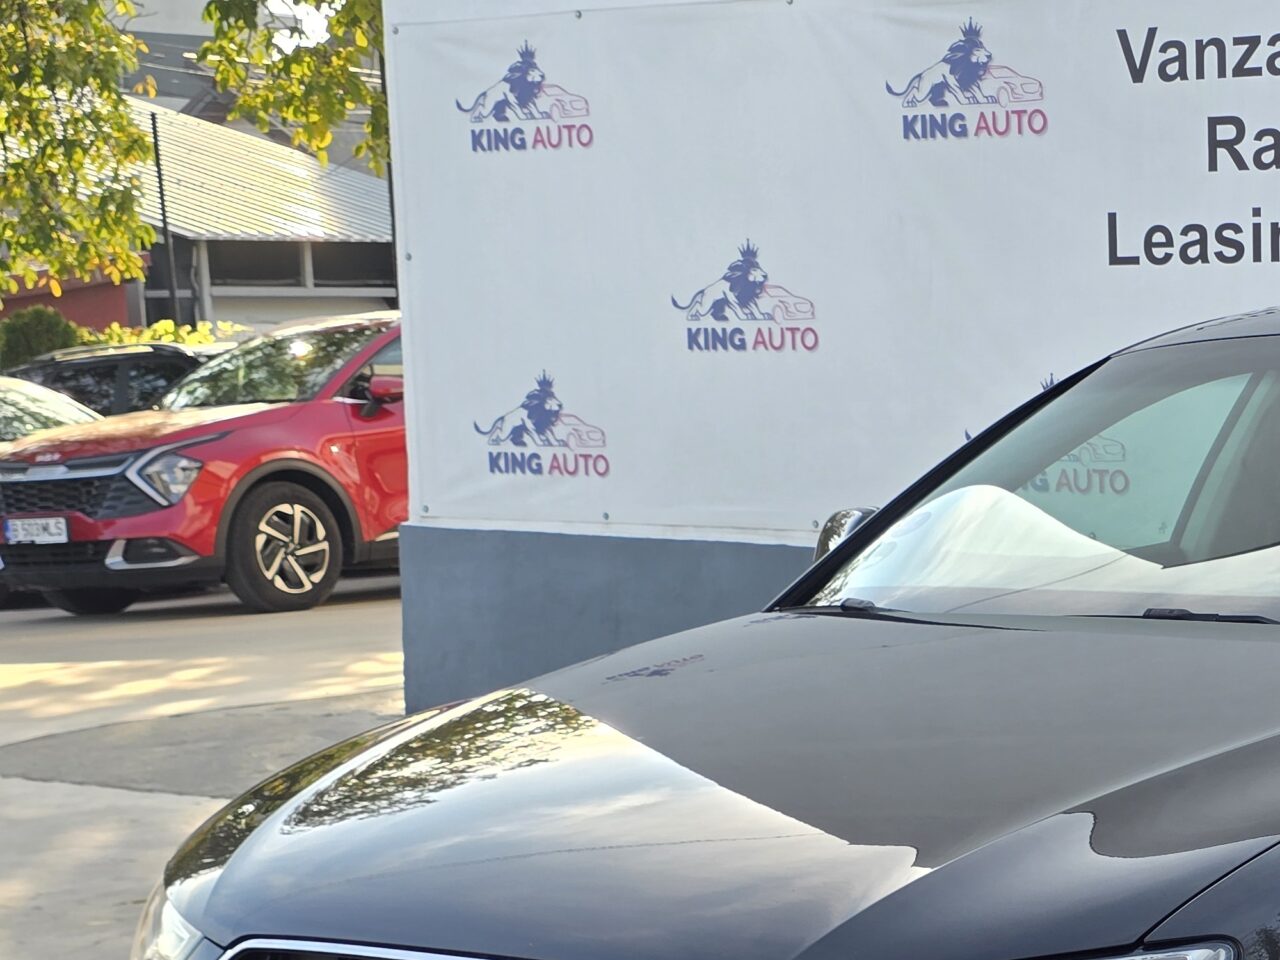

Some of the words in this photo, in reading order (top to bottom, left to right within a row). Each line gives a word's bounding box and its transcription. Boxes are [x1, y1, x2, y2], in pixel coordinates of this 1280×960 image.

[902, 113, 969, 141] KING
[974, 106, 1049, 138] AUTO
[471, 127, 528, 152] KING
[532, 123, 594, 150] AUTO
[687, 327, 747, 352] KING
[752, 326, 819, 352] AUTO
[488, 451, 544, 475] KING
[548, 451, 611, 478] AUTO
[1055, 469, 1131, 494] AUTO
